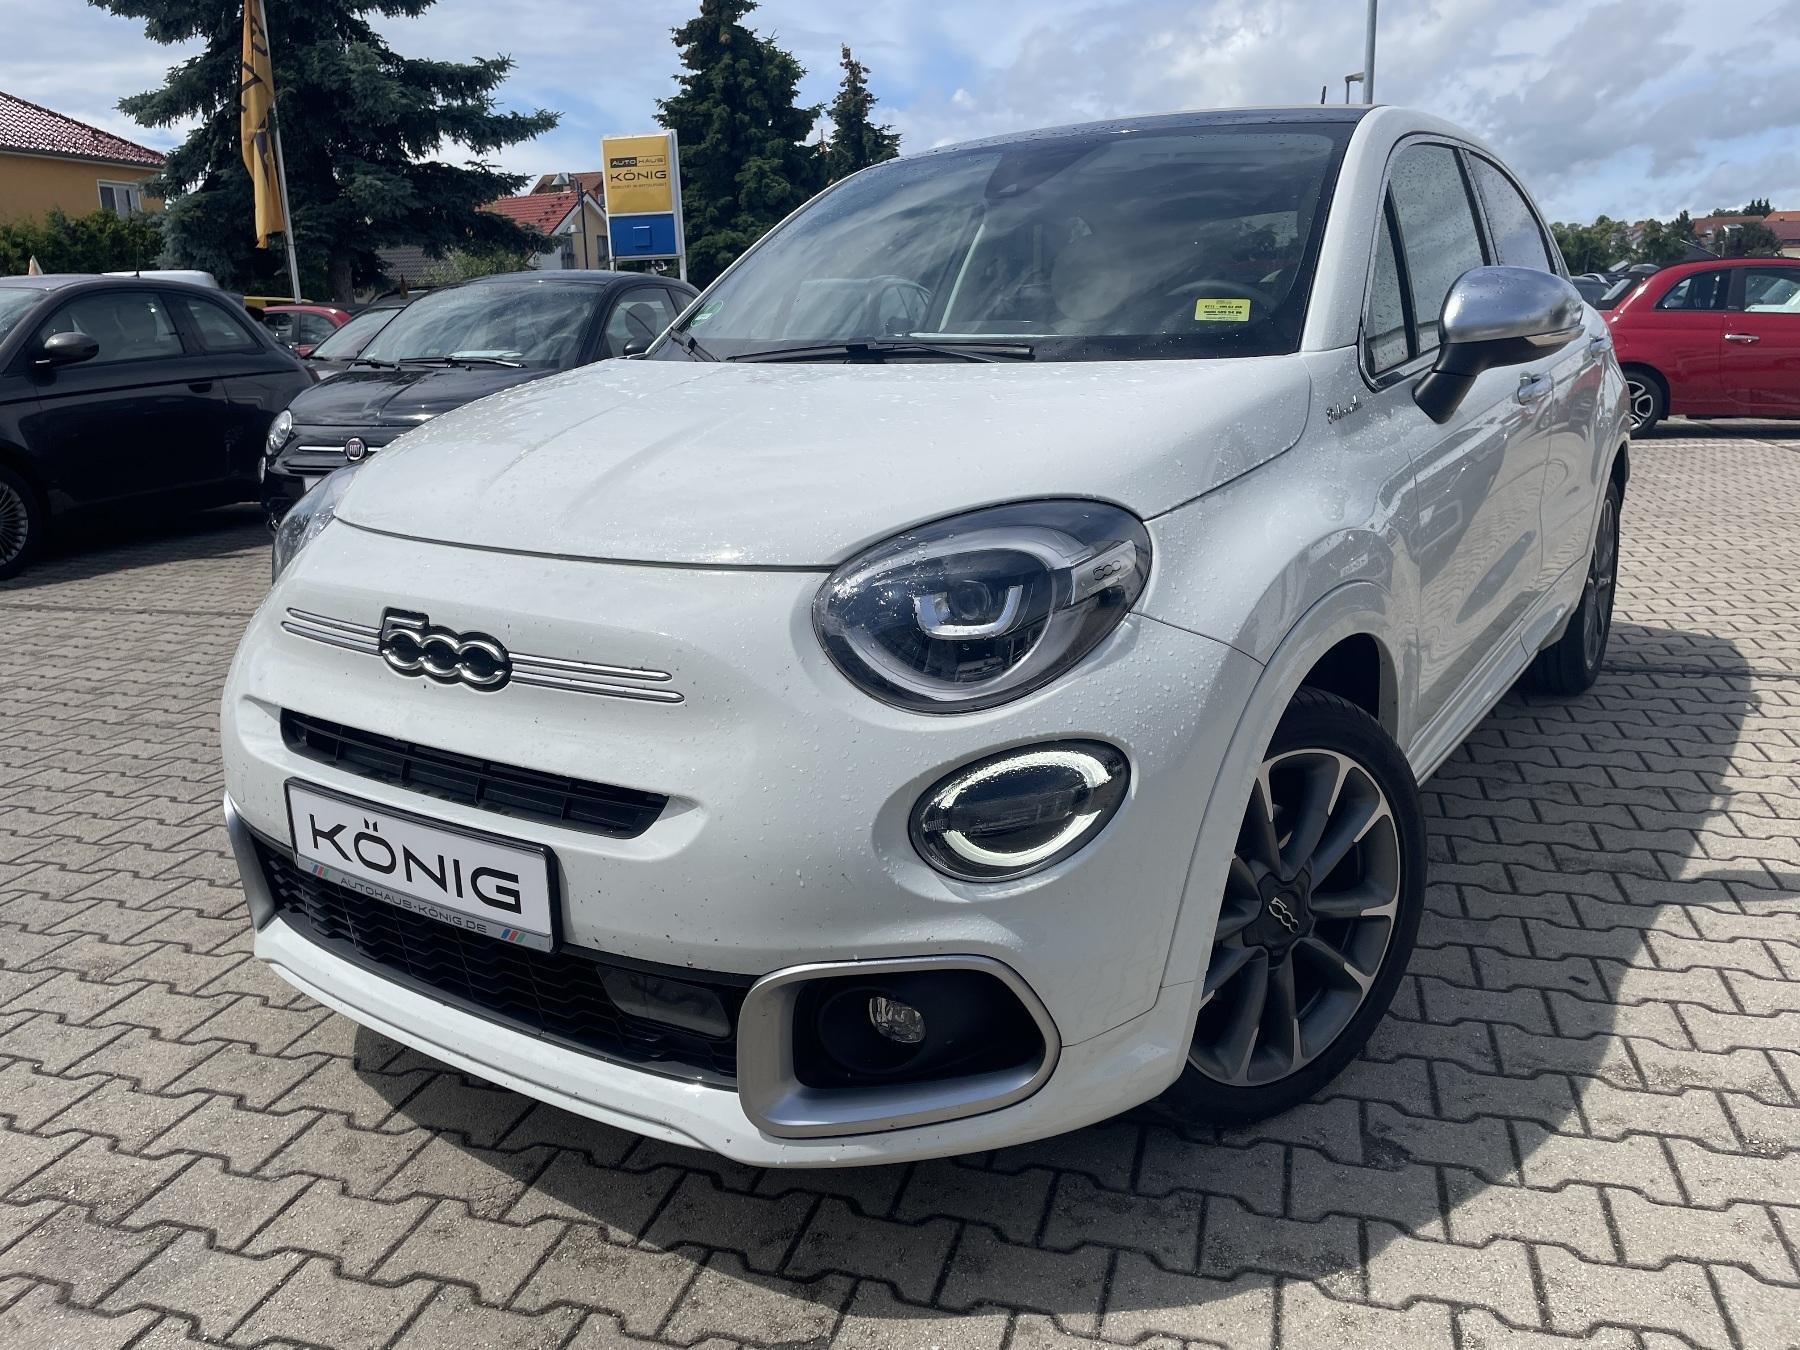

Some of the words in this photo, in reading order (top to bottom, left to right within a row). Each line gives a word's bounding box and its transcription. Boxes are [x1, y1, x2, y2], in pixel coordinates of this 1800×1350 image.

[610, 169, 667, 182] KÖNIG
[379, 608, 511, 691] 500
[309, 813, 522, 914] KÖNIG
[1268, 896, 1299, 934] 500
